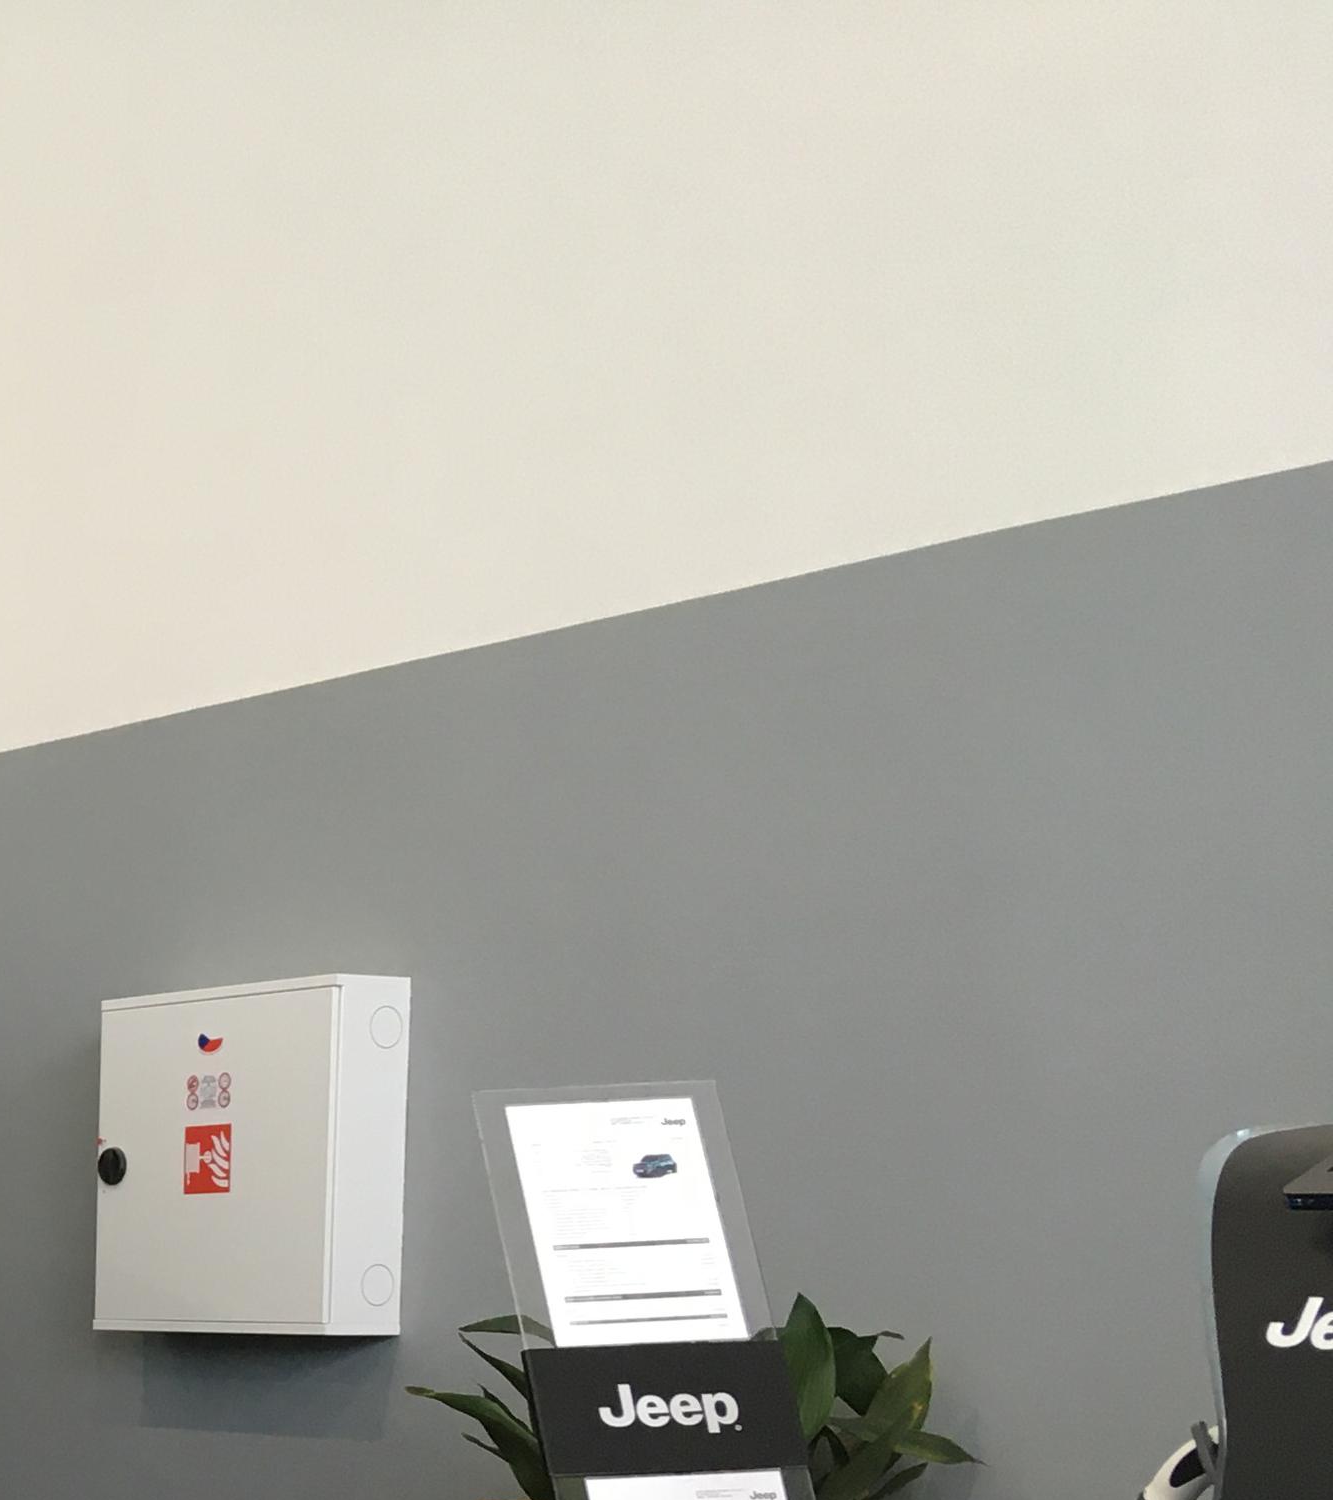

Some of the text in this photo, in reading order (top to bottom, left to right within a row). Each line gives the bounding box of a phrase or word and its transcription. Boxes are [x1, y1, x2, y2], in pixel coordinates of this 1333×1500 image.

[660, 1117, 687, 1127] Jeep
[597, 1383, 740, 1434] Jeep
[749, 1490, 778, 1500] Jeep
